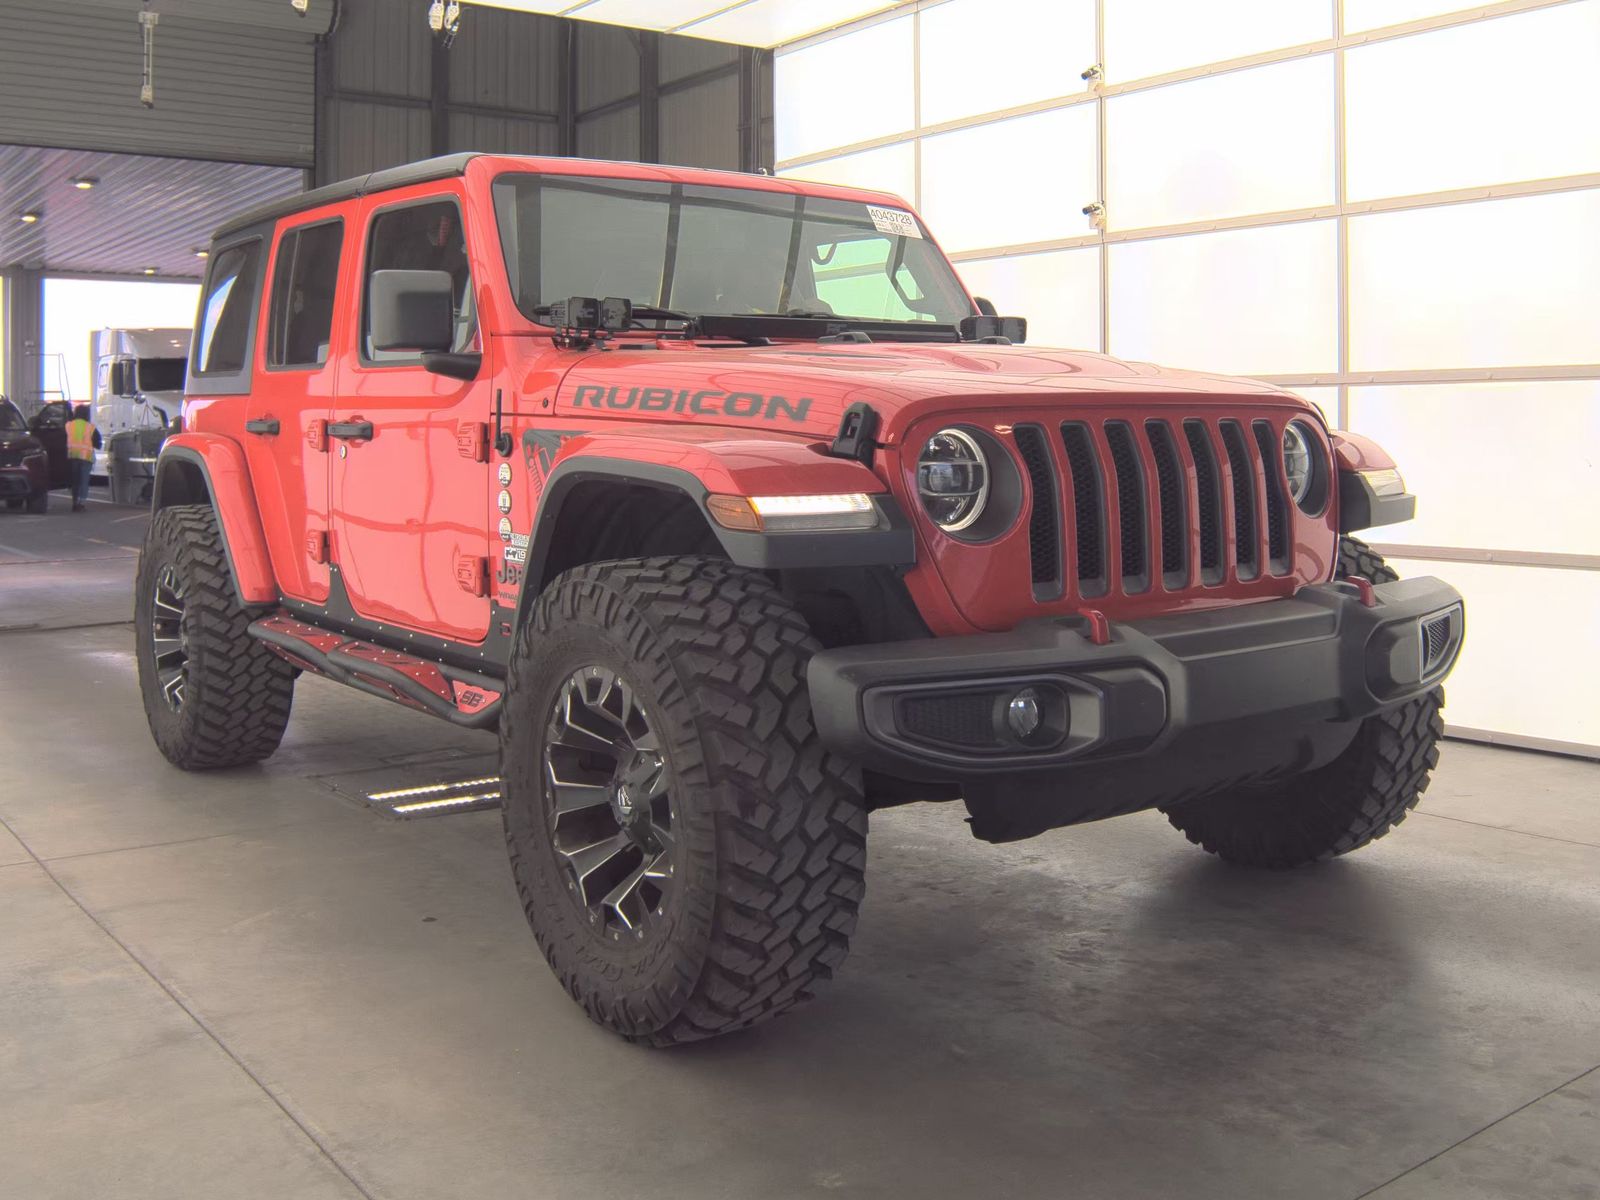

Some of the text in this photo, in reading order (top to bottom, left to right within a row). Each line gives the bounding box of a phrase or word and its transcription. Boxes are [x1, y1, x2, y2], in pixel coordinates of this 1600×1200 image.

[870, 209, 912, 225] 4043728
[574, 386, 813, 420] RUBICON
[496, 559, 522, 586] Jee
